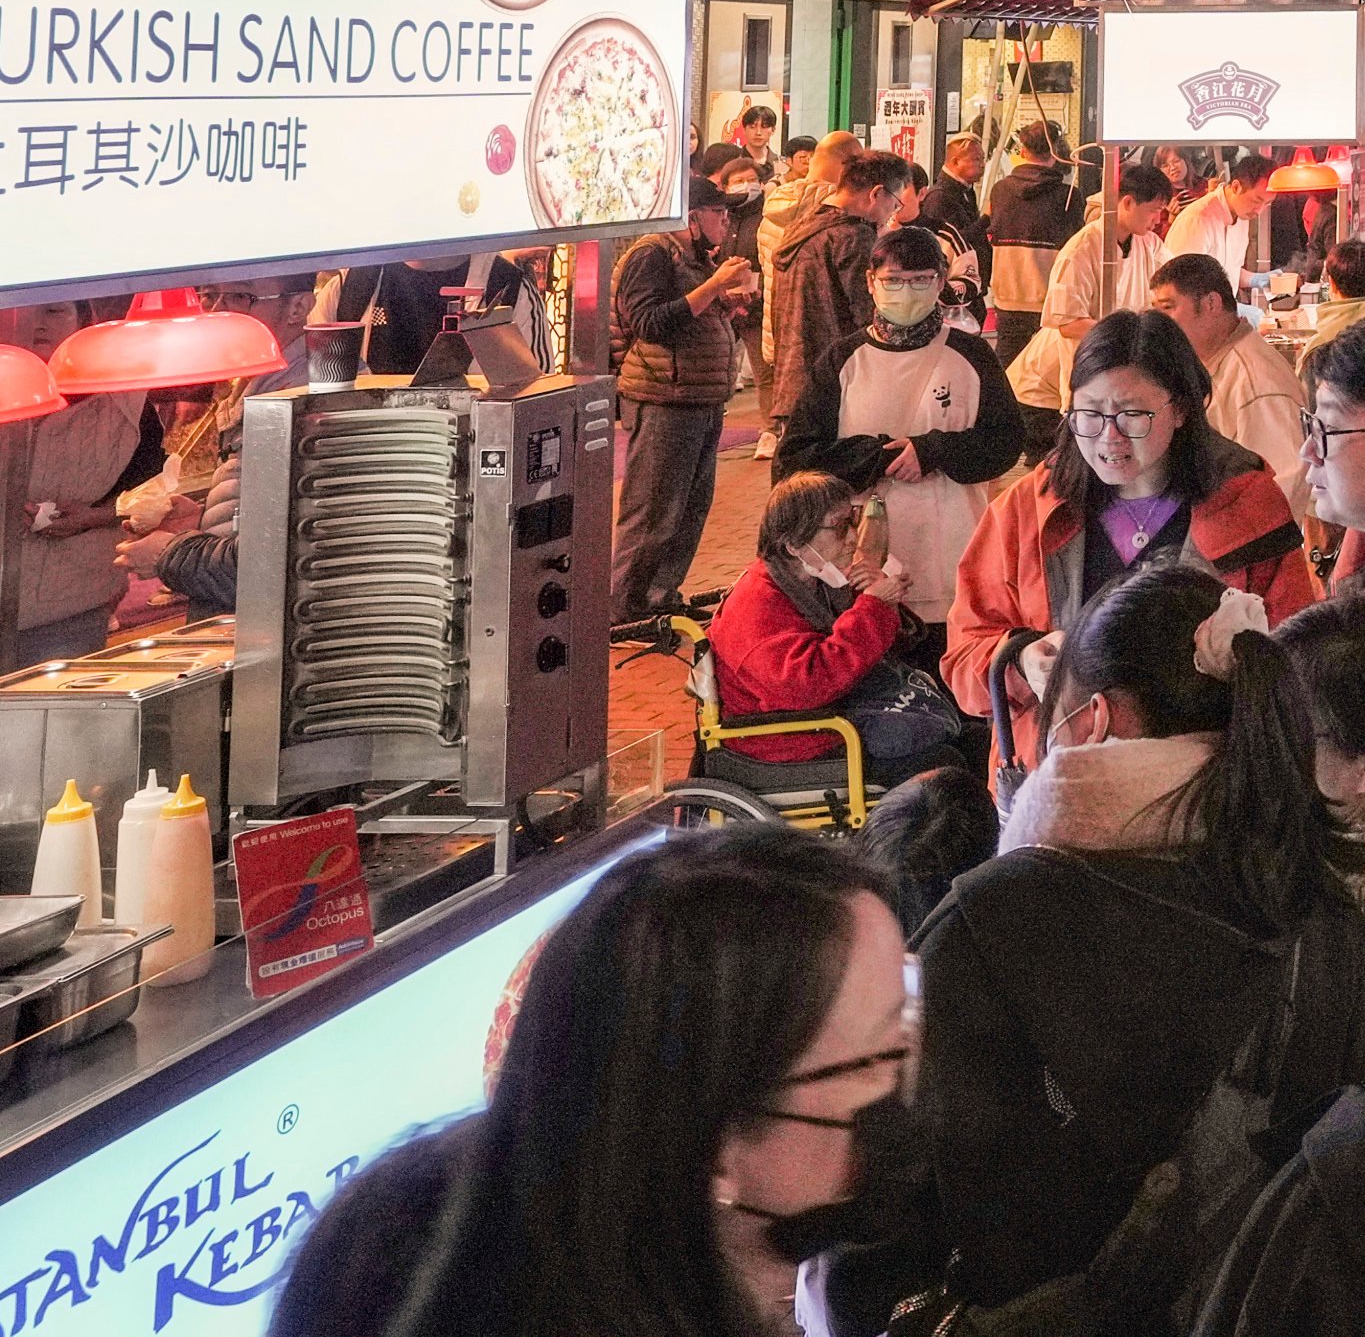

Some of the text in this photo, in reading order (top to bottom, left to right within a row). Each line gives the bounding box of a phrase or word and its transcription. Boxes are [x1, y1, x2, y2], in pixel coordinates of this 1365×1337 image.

[236, 11, 377, 86] SAND
[391, 19, 534, 84] COFFEE
[1194, 80, 1264, 103] 香江花月
[279, 822, 321, 843] Welcome
[322, 820, 331, 830] to
[333, 817, 349, 827] use
[324, 893, 363, 914] 八達通
[306, 906, 365, 931] Octopus
[0, 1128, 275, 1337] TANBUL
